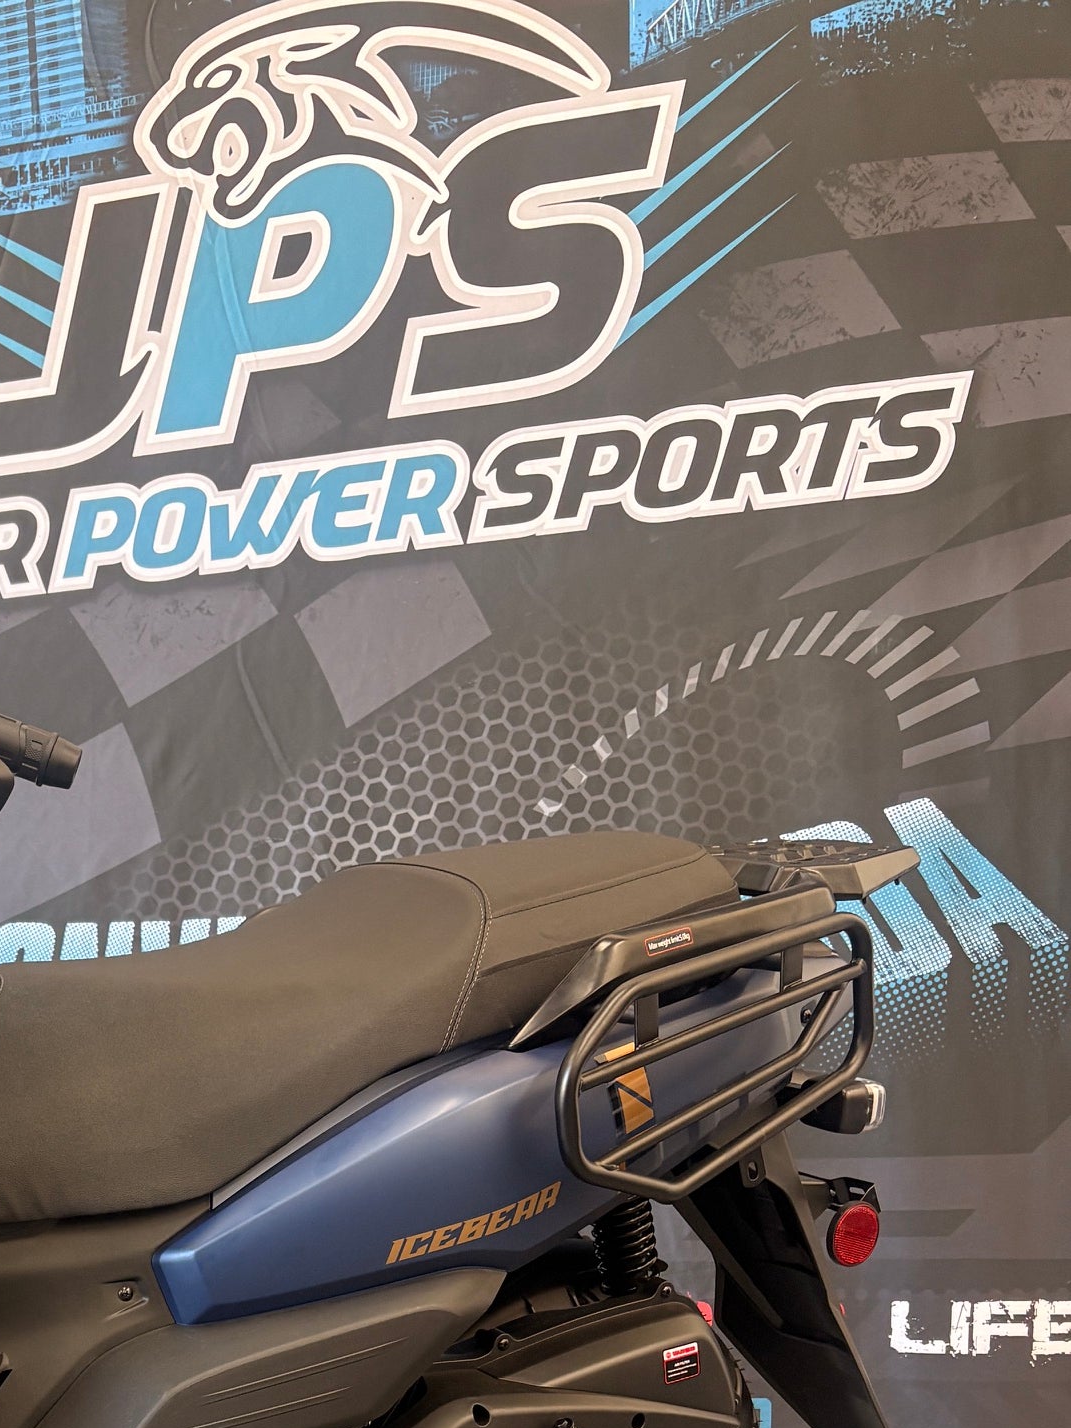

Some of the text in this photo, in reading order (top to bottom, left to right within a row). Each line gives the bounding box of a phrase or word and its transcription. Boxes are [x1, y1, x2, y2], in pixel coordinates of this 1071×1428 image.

[50, 450, 466, 593] POWER
[469, 373, 973, 543] SPORTS
[386, 1181, 562, 1265] ICEBEAR
[889, 1299, 1071, 1366] LIFE
